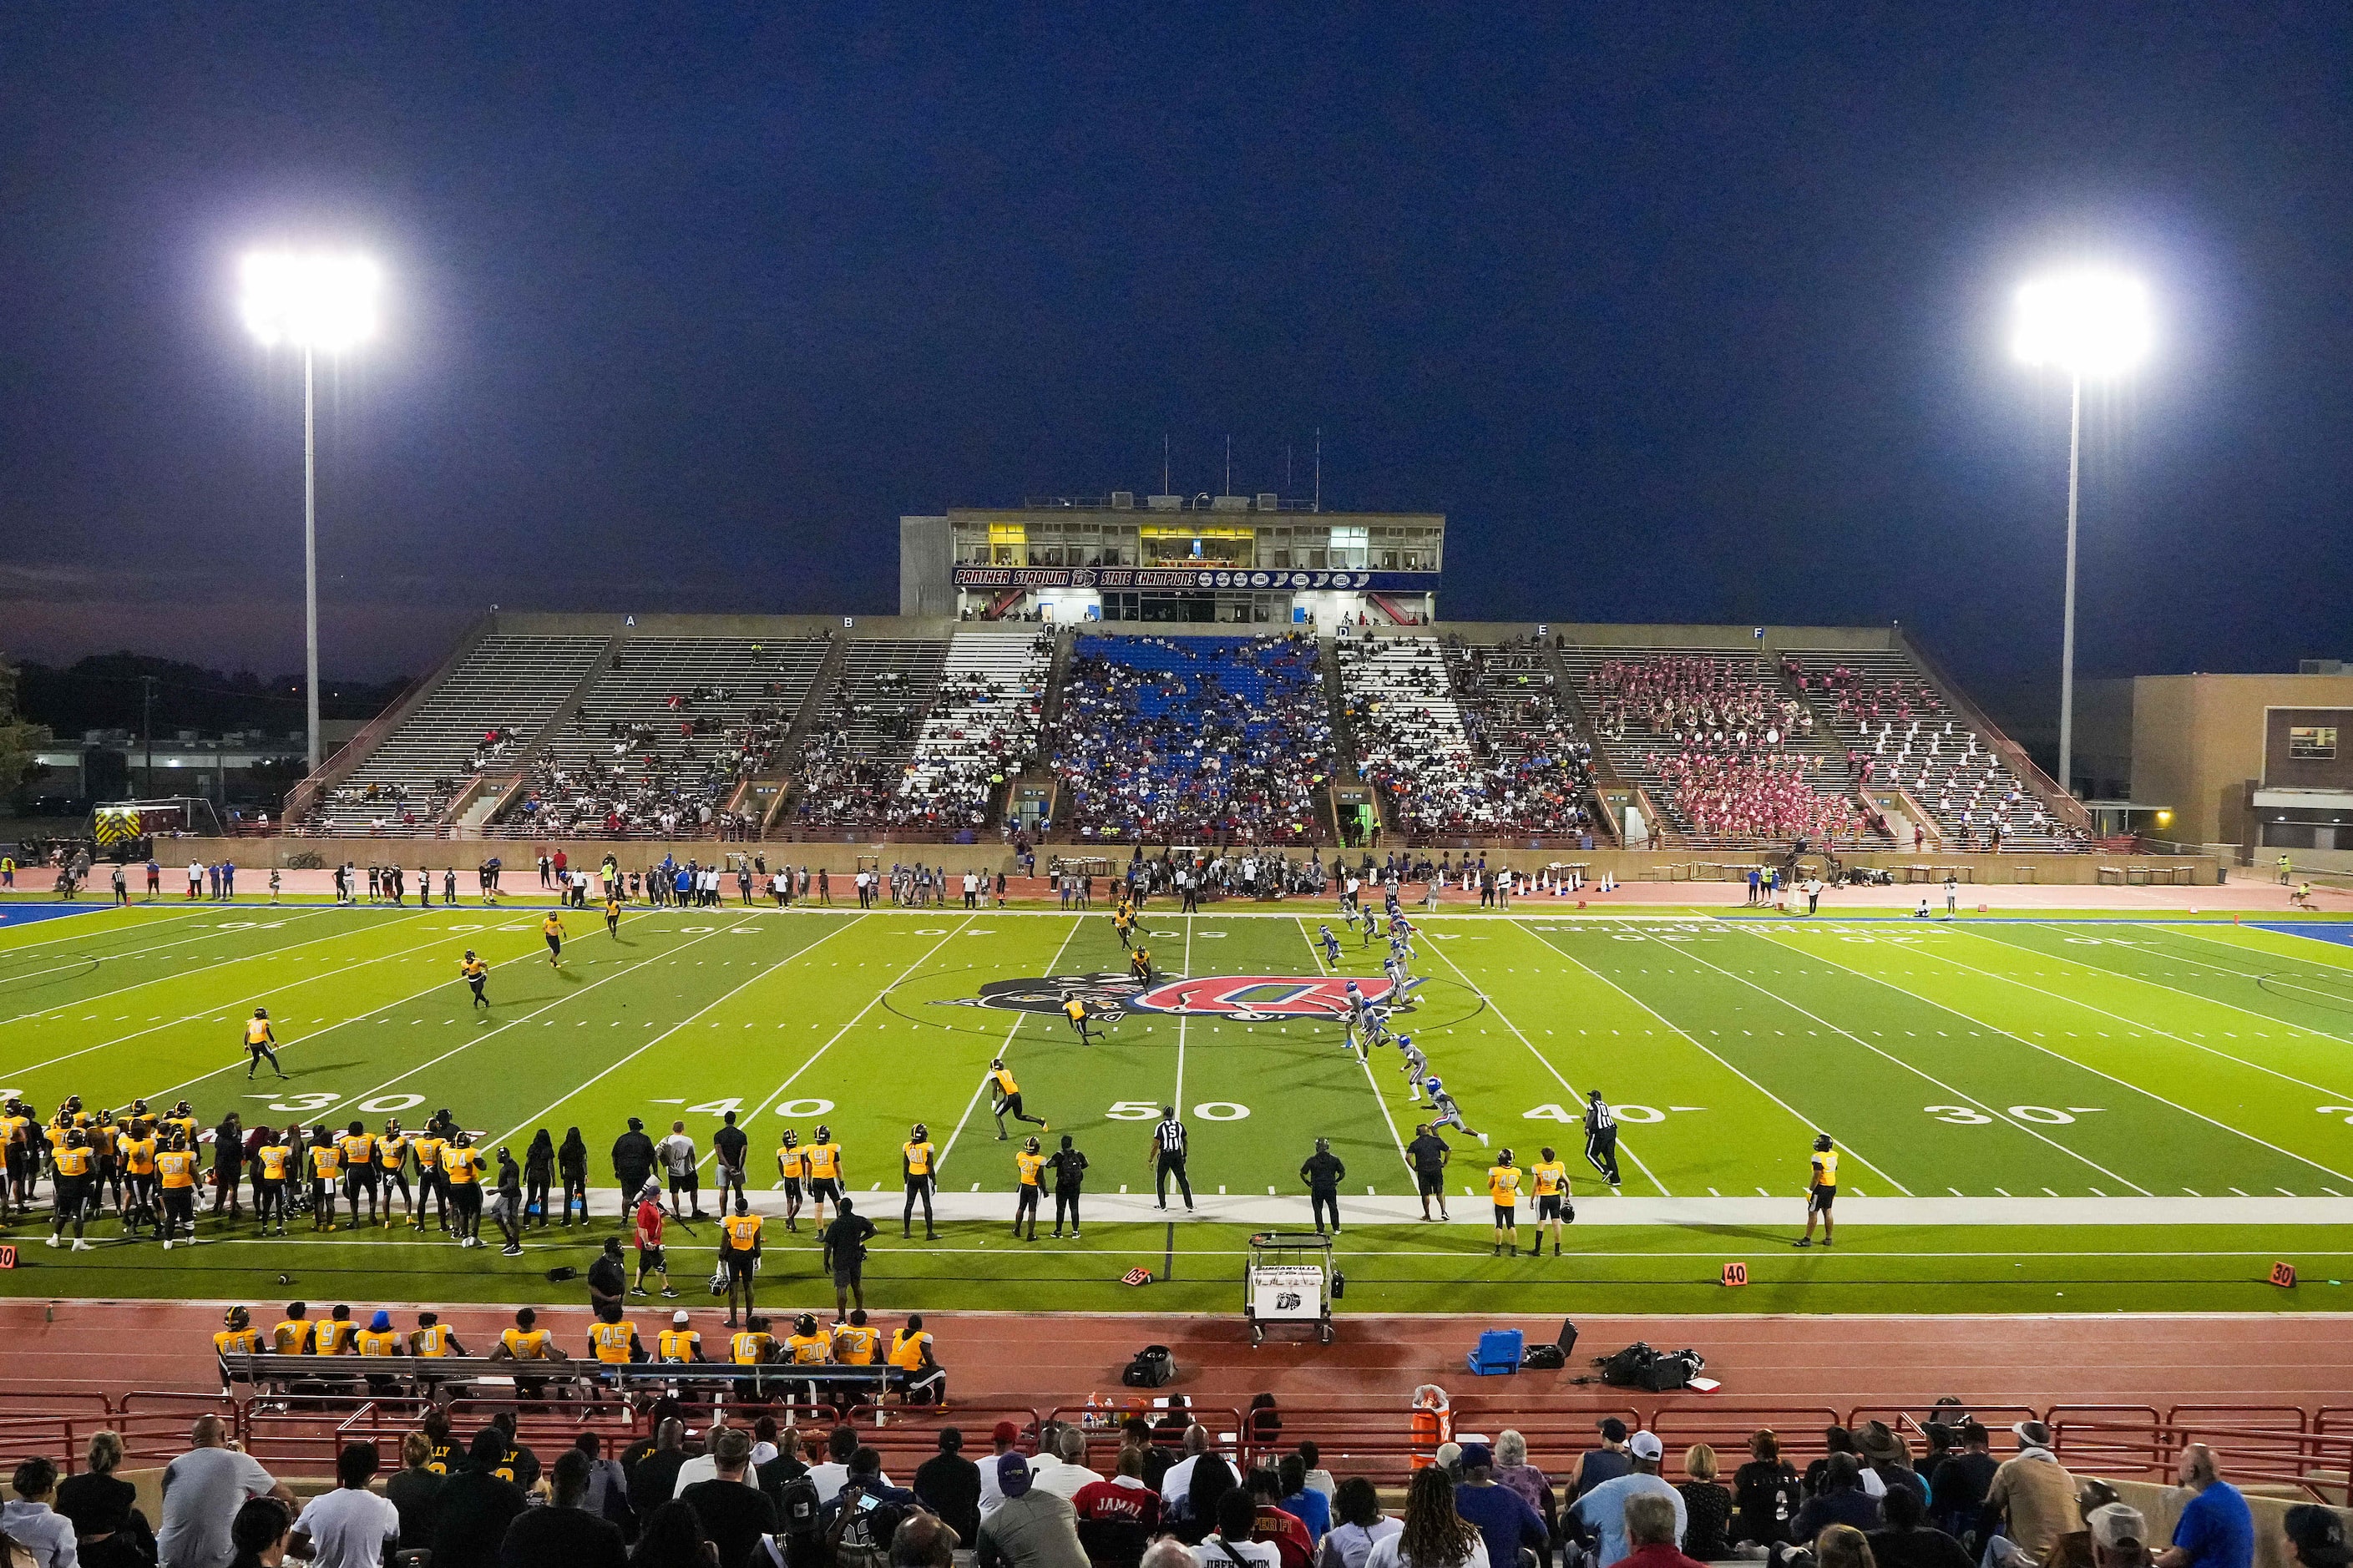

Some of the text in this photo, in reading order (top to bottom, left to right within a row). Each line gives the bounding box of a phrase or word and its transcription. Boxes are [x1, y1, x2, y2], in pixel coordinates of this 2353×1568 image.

[955, 569, 1070, 584] PANTHER STADIUM
[1101, 571, 1132, 585] STATE
[1135, 571, 1197, 586] CHAMPIONS
[625, 616, 635, 626] A
[843, 618, 853, 628] B
[1044, 624, 1055, 638] C
[1338, 627, 1348, 636] D
[1539, 625, 1546, 635] E
[1754, 628, 1763, 638] F
[1151, 930, 1228, 938] 50
[268, 1093, 425, 1113] 30
[686, 1098, 835, 1118] 40
[1105, 1101, 1251, 1121] 50
[1522, 1103, 1666, 1124] 40
[1923, 1105, 2077, 1125] 30
[1168, 1125, 1177, 1138] S
[347, 1139, 367, 1157] 56
[423, 1145, 433, 1161] 3
[908, 1148, 923, 1164] 81
[162, 1156, 184, 1174] 58
[448, 1153, 468, 1168] 74
[813, 1151, 828, 1166] 91
[1020, 1159, 1034, 1175] 21
[1499, 1175, 1516, 1188] 49
[736, 1222, 752, 1241] 41
[1726, 1265, 1747, 1283] 40
[2273, 1264, 2291, 1284] 30
[321, 1323, 335, 1346] 9
[600, 1327, 627, 1348] 45
[738, 1336, 757, 1358] 16
[801, 1341, 826, 1362] 30
